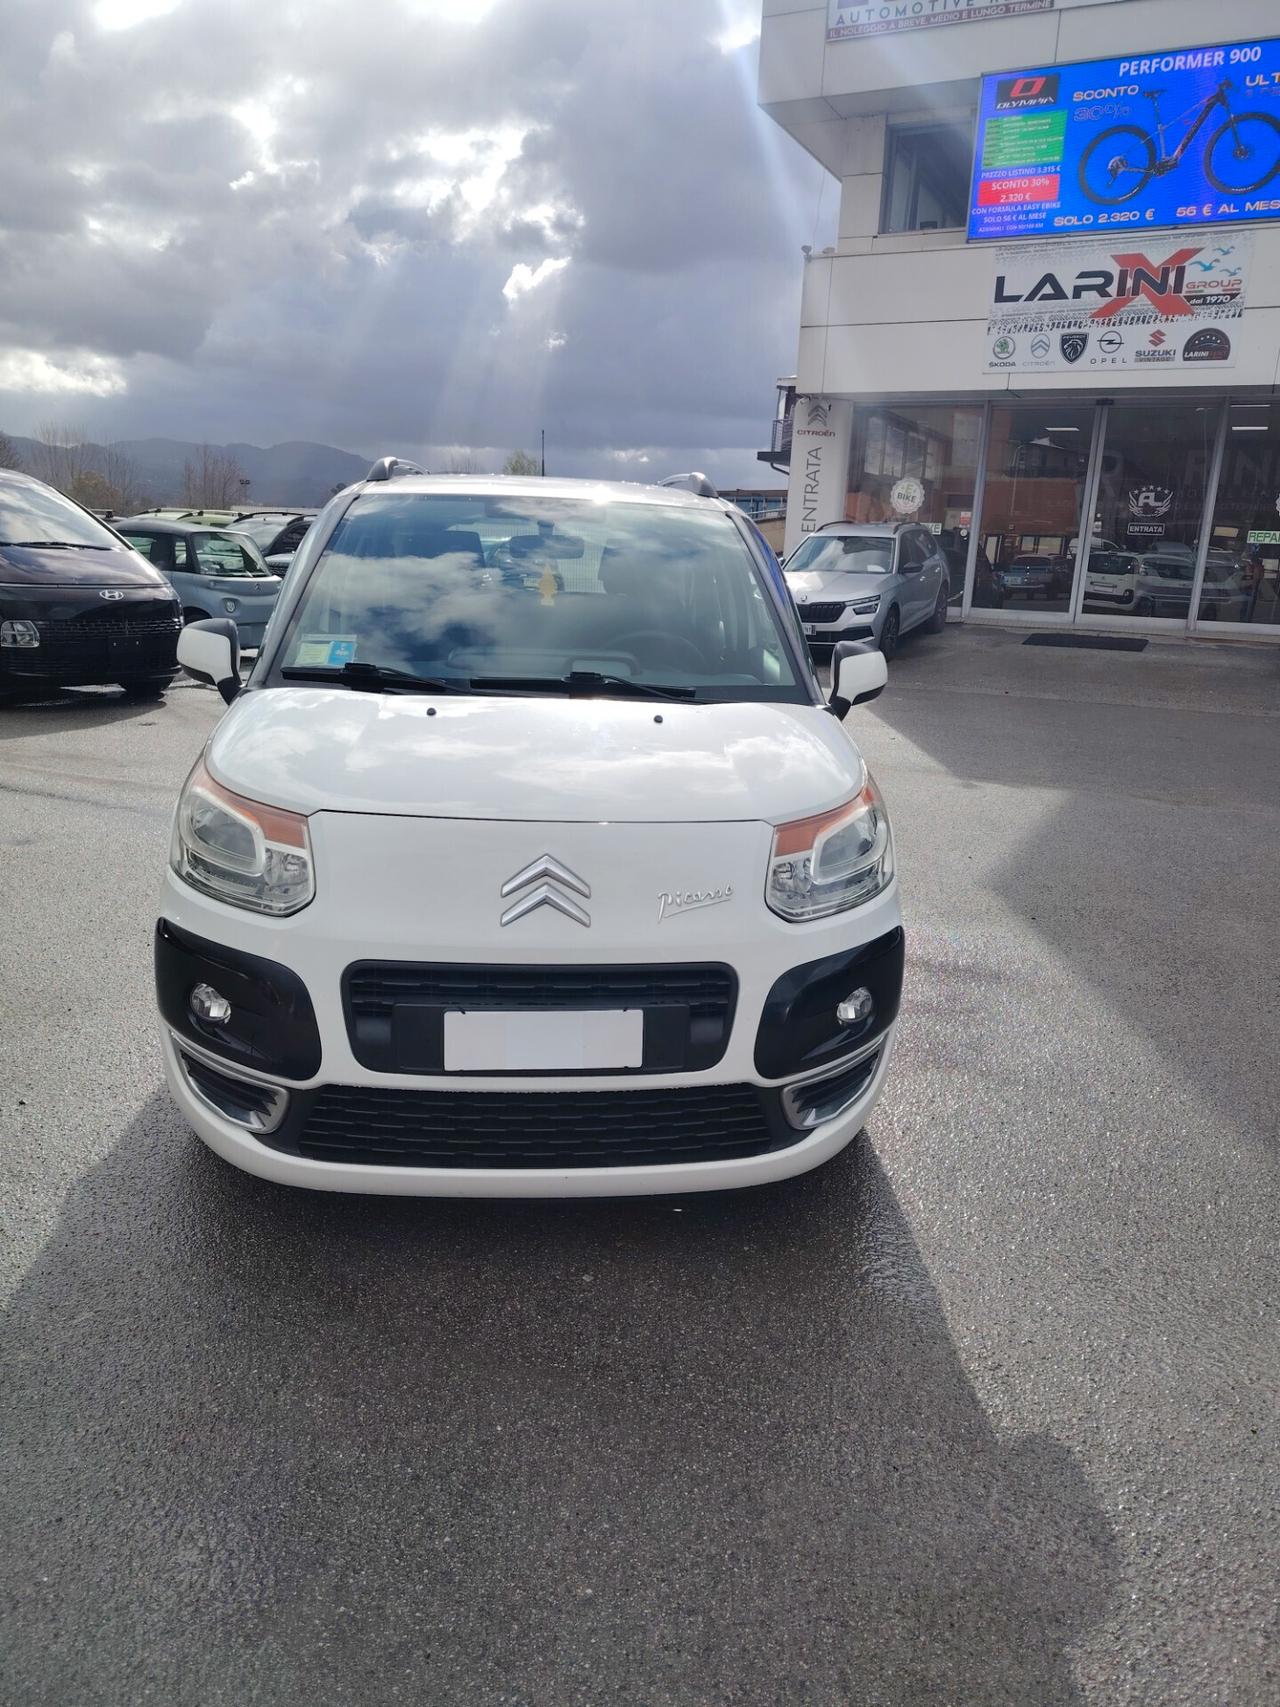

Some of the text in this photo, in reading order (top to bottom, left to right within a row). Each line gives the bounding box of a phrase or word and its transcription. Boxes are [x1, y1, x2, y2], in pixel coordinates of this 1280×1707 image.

[840, 24, 885, 37] NOLEGGIO
[930, 12, 961, 24] MEDIO
[970, 6, 1006, 17] LUNGO
[1009, 0, 1050, 13] TERMINE
[1119, 46, 1262, 77] PERFORMER 900
[1073, 85, 1139, 102] SCONTO
[996, 96, 1055, 109] OLYMPIA
[1073, 103, 1131, 122] 30%
[981, 171, 1007, 179] PREZZO
[1008, 167, 1036, 176] LISTINO
[992, 178, 1050, 191] SCONTO 30%
[1000, 193, 1024, 203] 2.320
[971, 207, 987, 215] CON
[988, 204, 1022, 214] FORMULA
[1023, 203, 1040, 211] EASY
[1054, 213, 1094, 227] SOLO
[1097, 210, 1140, 224] 2.320
[1145, 208, 1155, 221] €
[1175, 206, 1197, 217] 56
[1202, 205, 1213, 216] €
[1217, 204, 1239, 215] AL
[983, 215, 1002, 224] SOLO
[1028, 212, 1047, 220] MESE
[994, 264, 1187, 303] LARINI
[1186, 279, 1242, 289] GROUP
[1206, 295, 1230, 304] 1970
[1135, 349, 1176, 358] SUZUKI
[801, 446, 822, 533] ENTRATA
[897, 492, 917, 504] BIKE
[657, 883, 733, 924] Picasso
